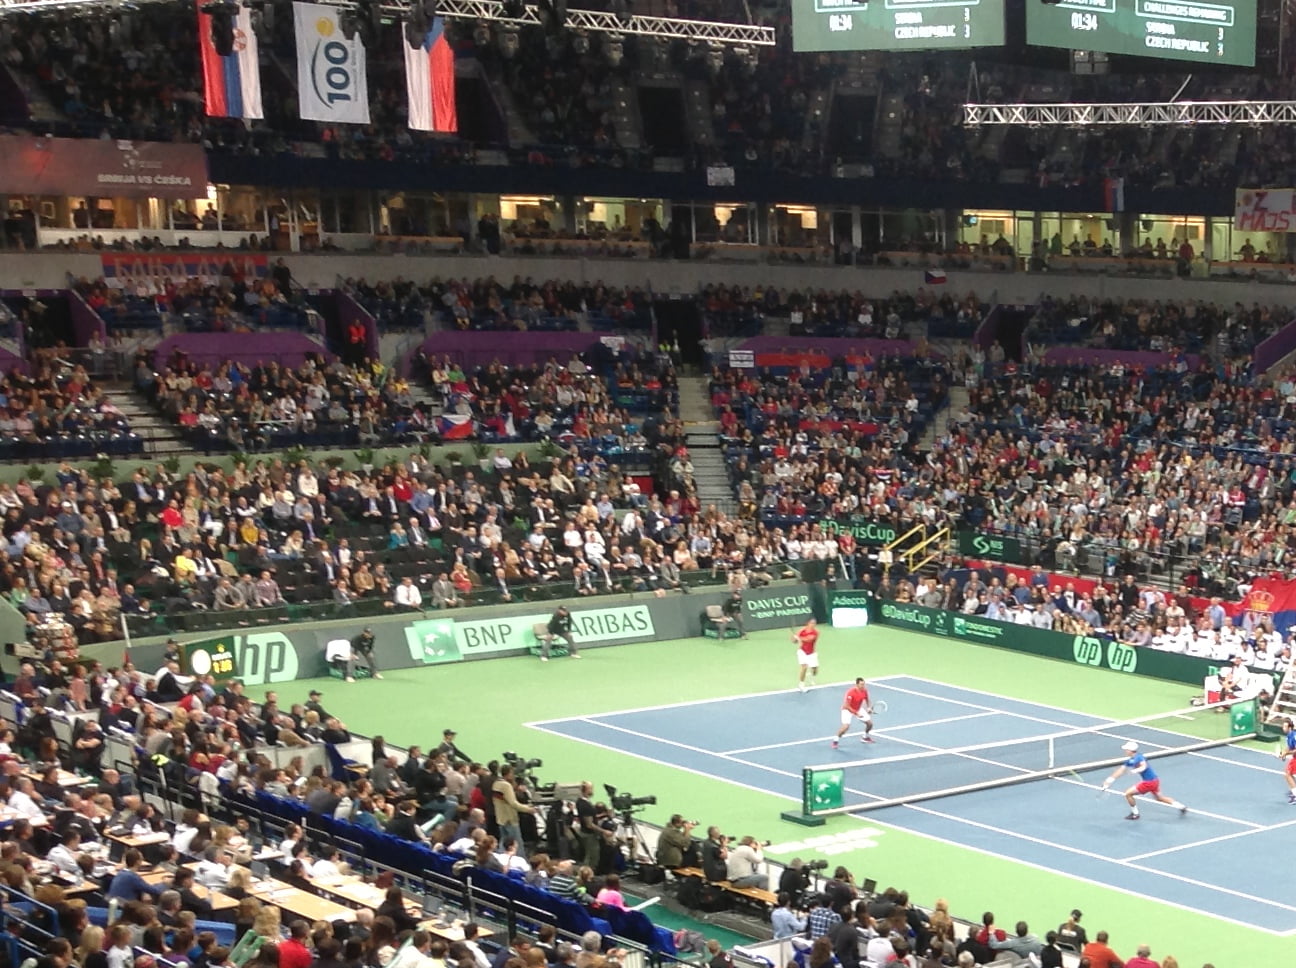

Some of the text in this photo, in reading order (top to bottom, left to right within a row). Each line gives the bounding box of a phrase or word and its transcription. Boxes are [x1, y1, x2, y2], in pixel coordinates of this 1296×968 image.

[324, 41, 351, 104] 100
[819, 520, 896, 543] #DavisCup
[747, 595, 809, 611] DAVIS CUP
[464, 611, 648, 648] BNP ARIBAS
[237, 633, 287, 684] hp
[1076, 637, 1135, 672] hp hp
